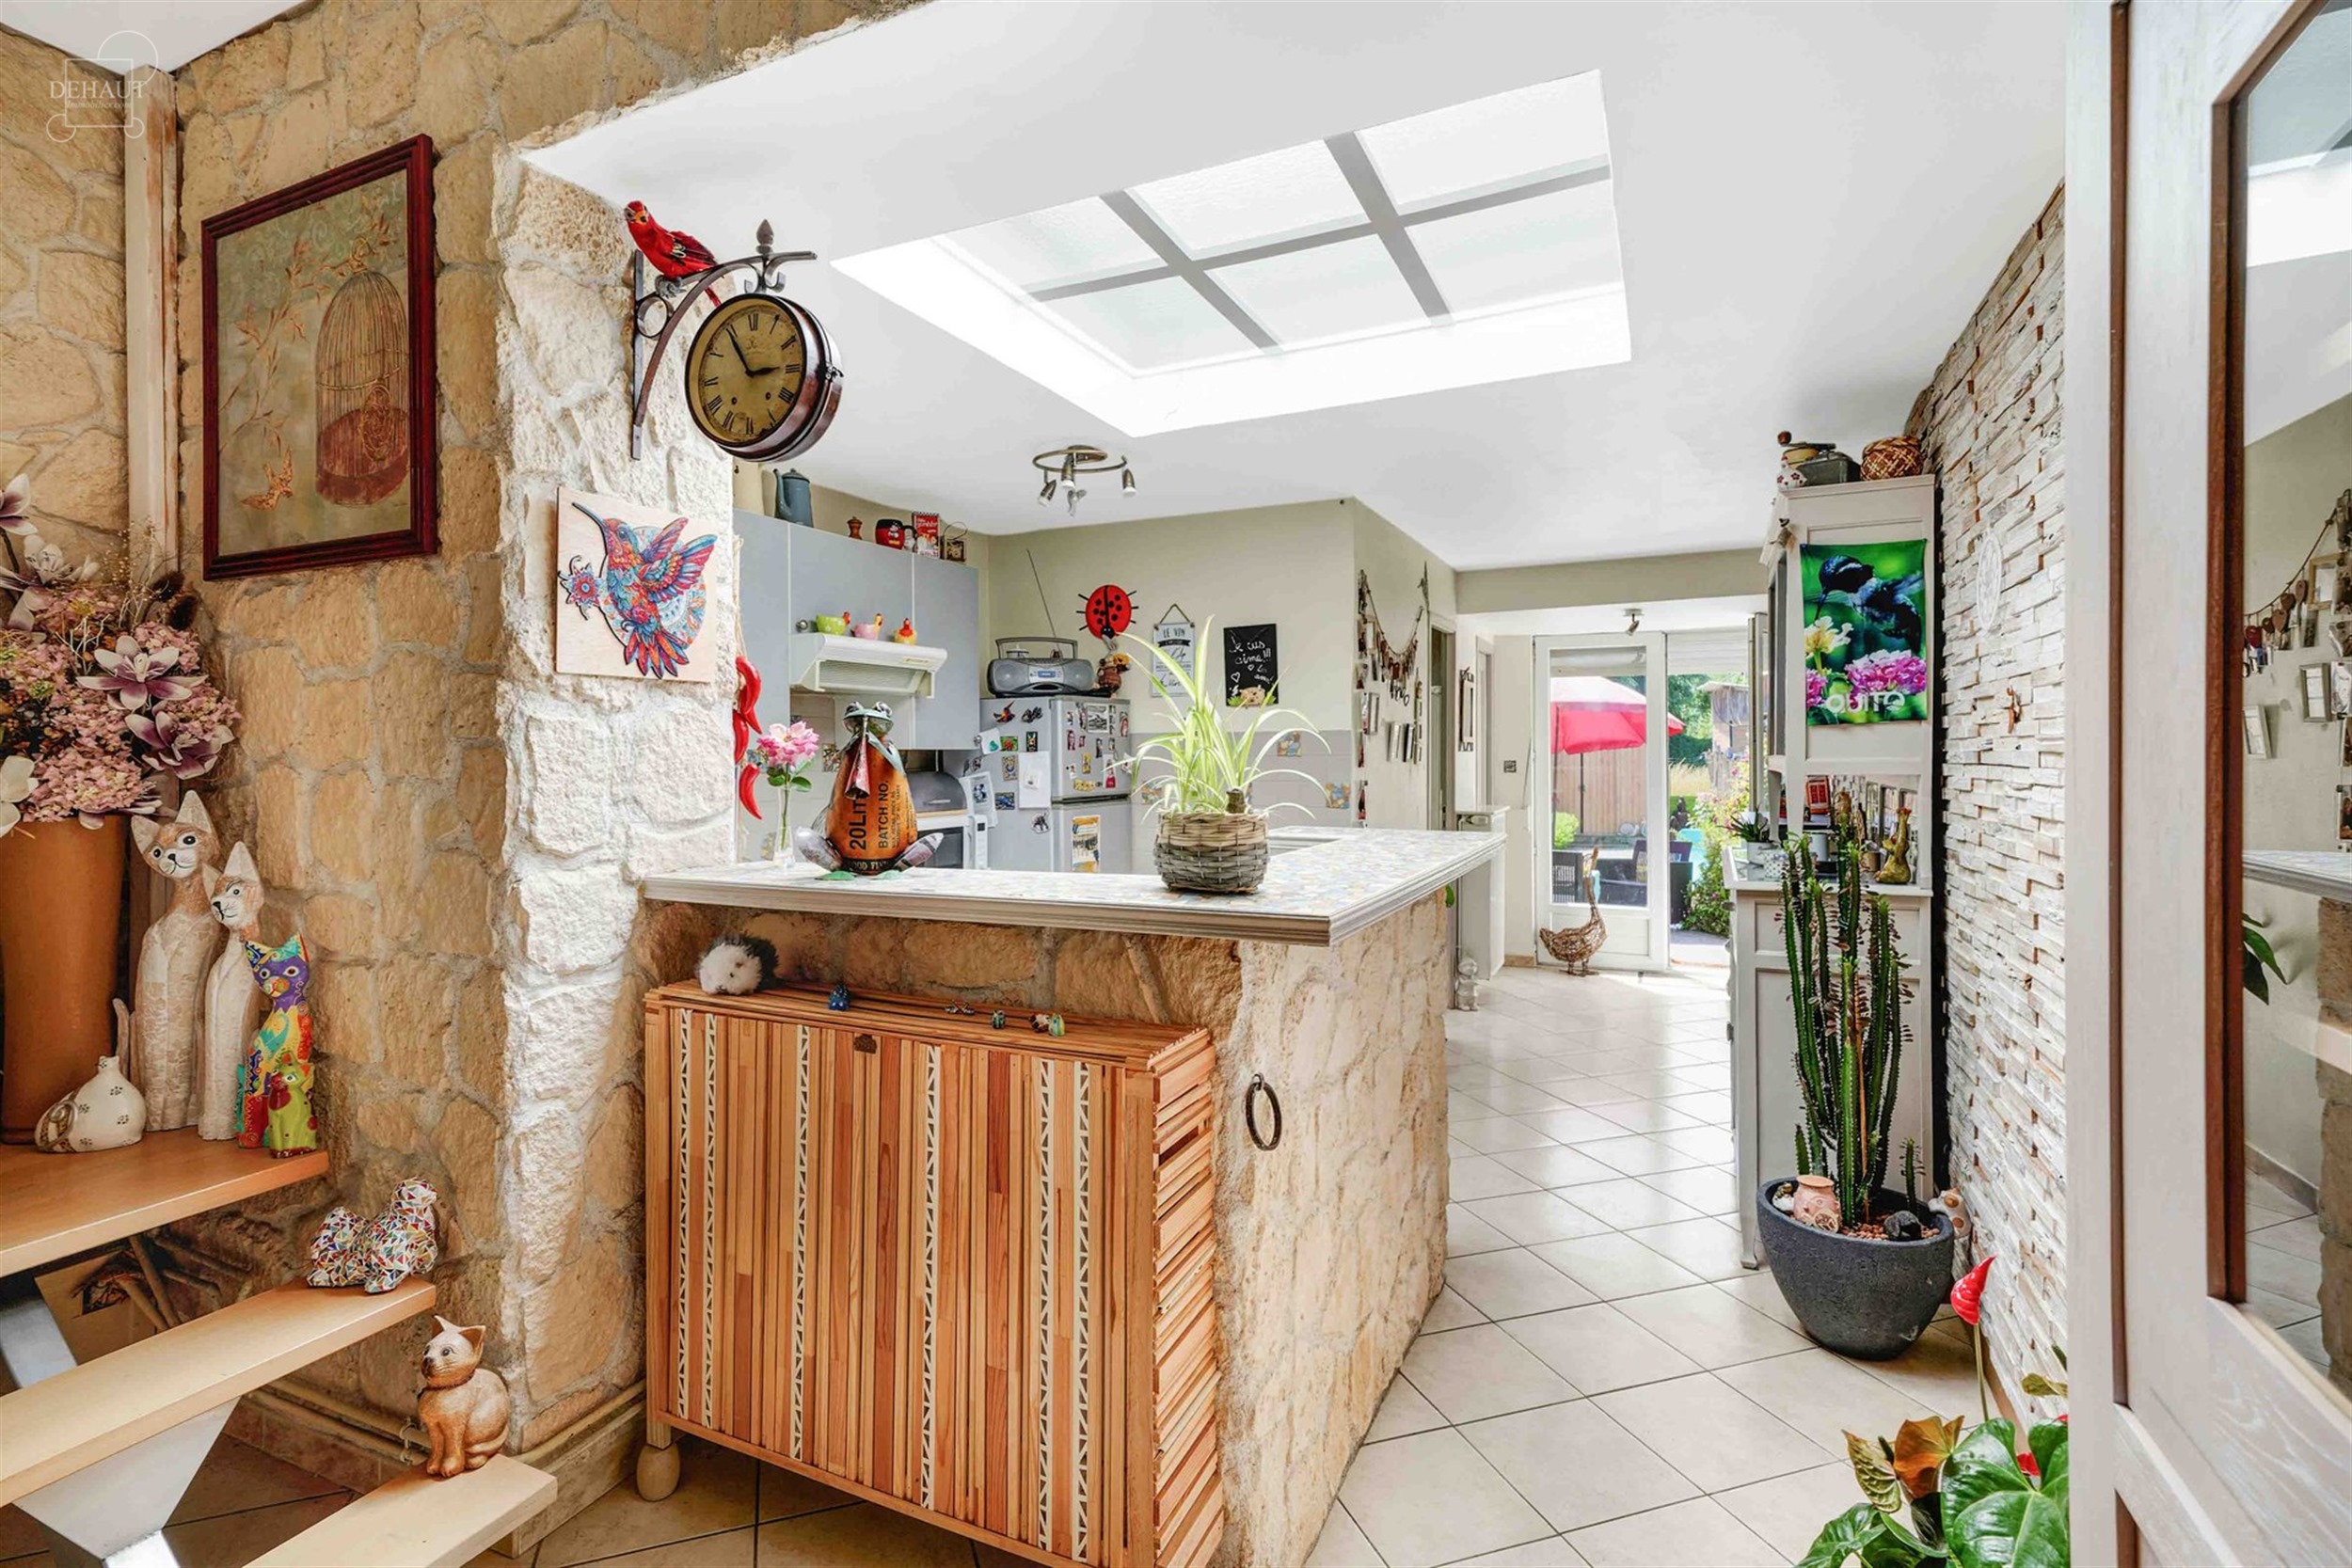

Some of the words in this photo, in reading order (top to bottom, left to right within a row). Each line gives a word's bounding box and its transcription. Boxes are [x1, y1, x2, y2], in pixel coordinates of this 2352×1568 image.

[1824, 690, 1905, 714] QUITO
[878, 780, 889, 801] NO.
[878, 807, 889, 848] BATCH
